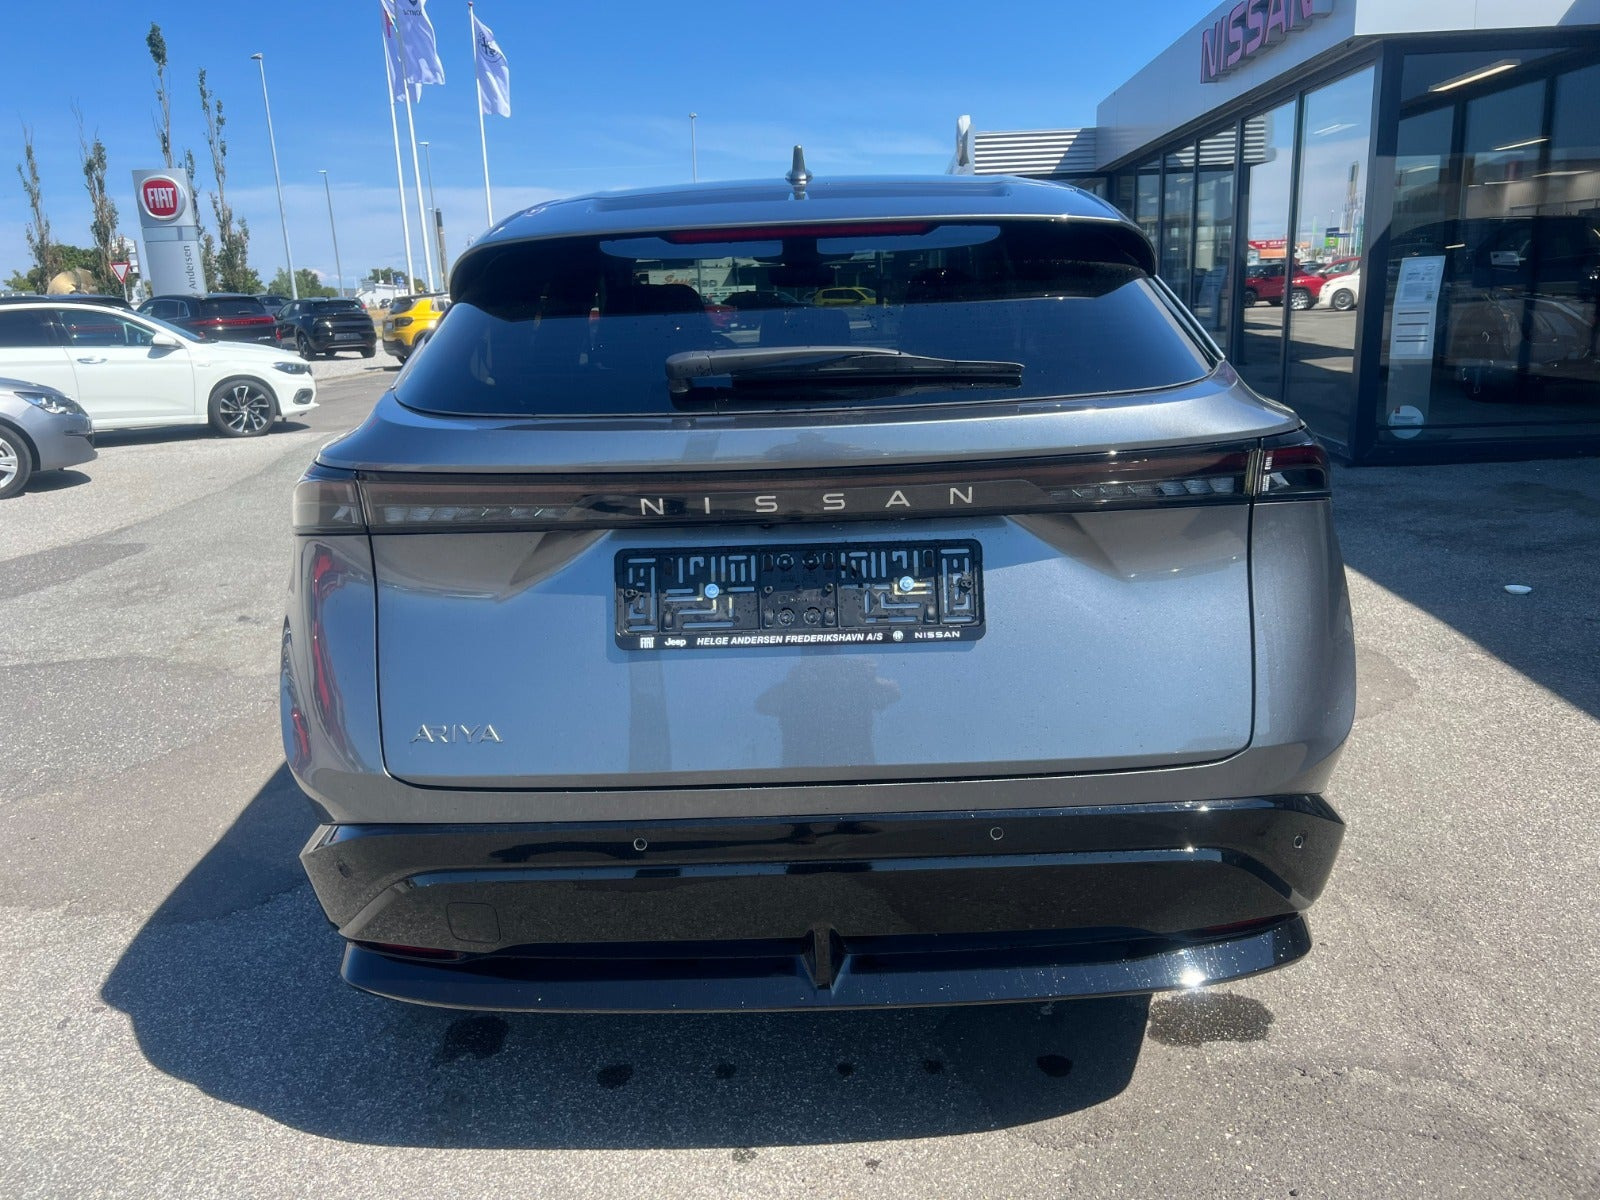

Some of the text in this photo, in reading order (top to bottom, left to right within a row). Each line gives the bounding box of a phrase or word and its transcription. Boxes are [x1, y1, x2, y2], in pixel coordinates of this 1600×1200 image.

[146, 187, 174, 209] FIAT
[183, 245, 198, 290] Andersen
[640, 486, 973, 515] NISSAN
[640, 637, 655, 649] FIAT
[664, 638, 687, 647] Jeep
[696, 632, 883, 646] HELGE ANDERSEN FREDERIKSHAVN A/S
[914, 631, 961, 639] NISSAN
[409, 724, 503, 743] ARIYA
